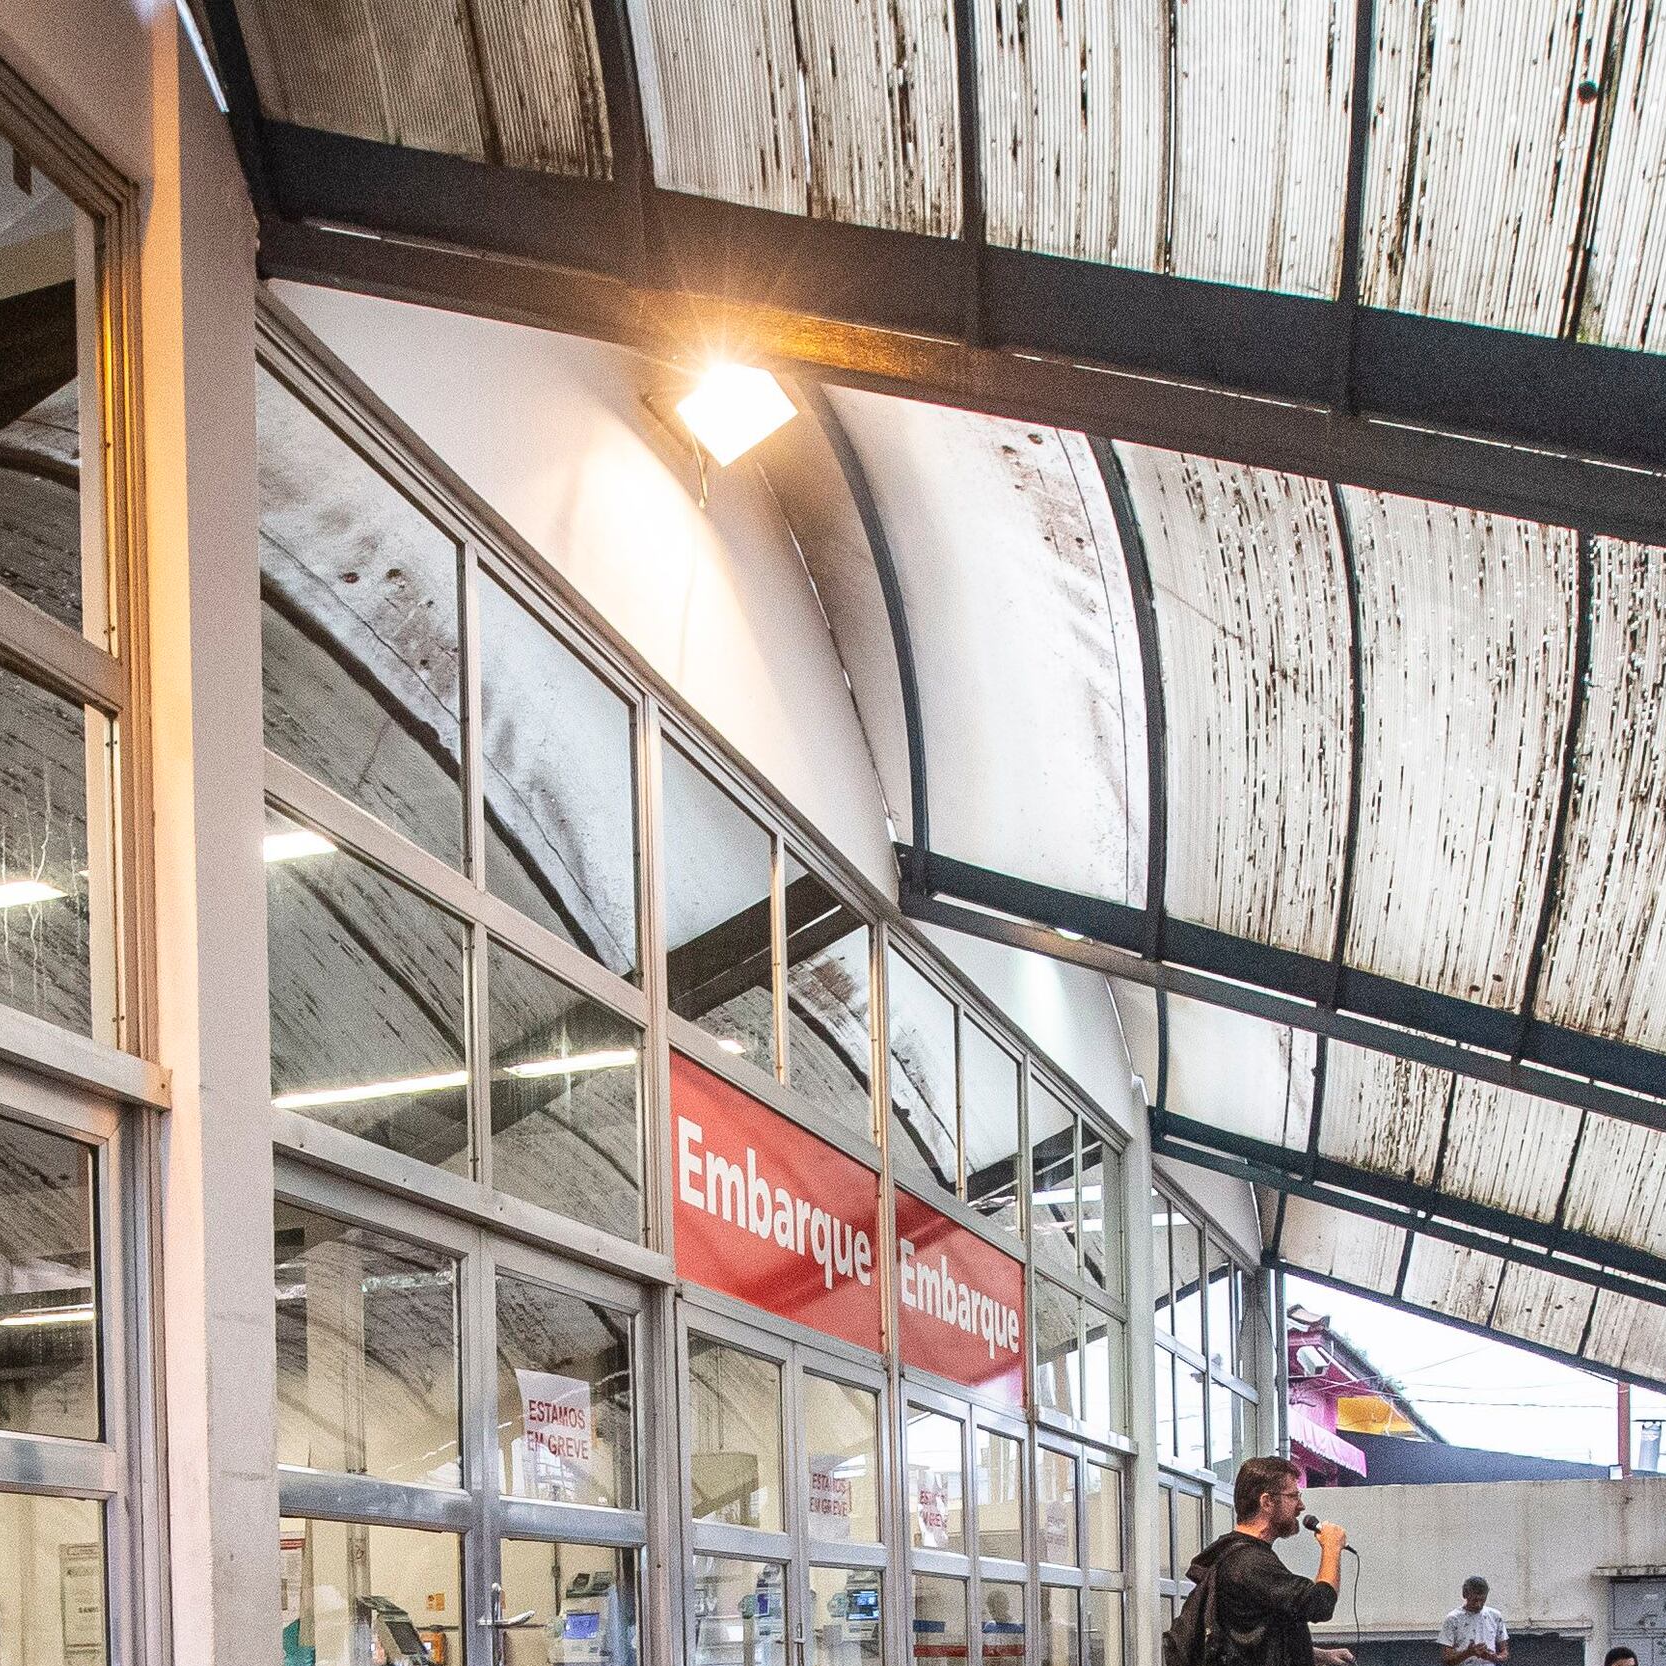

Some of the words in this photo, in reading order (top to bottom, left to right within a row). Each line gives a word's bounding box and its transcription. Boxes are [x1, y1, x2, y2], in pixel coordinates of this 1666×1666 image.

[677, 1115, 873, 1290] Embarque
[899, 1237, 1020, 1360] Embarque
[528, 1399, 586, 1430] ESTAMOS
[547, 1433, 589, 1459] GREVE
